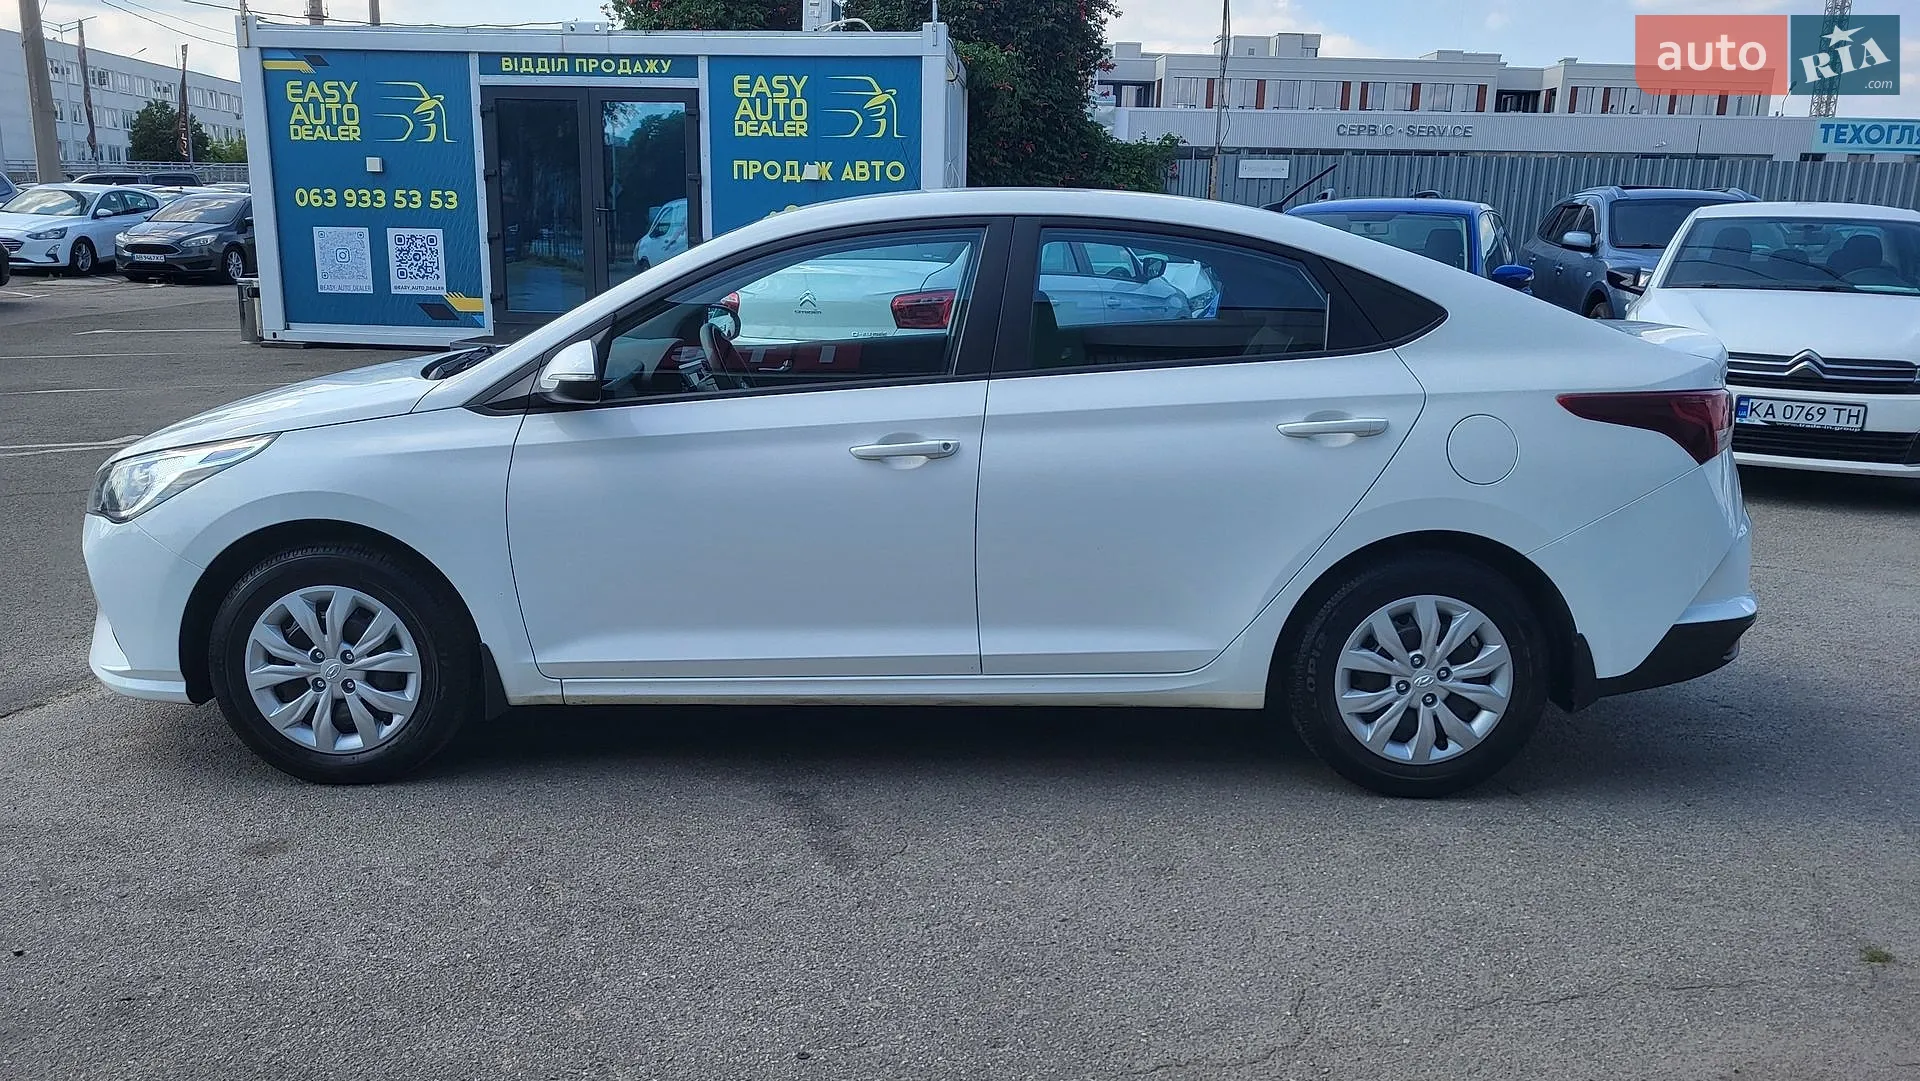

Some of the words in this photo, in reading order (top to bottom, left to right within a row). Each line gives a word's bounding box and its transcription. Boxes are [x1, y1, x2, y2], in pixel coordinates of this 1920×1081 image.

[501, 57, 569, 74] ВІДДІЛ
[575, 58, 672, 75] ПРОДАЖУ
[286, 80, 359, 103] EASY
[733, 75, 809, 98] EASY
[289, 103, 360, 125] AUTO
[734, 98, 808, 121] AUTO
[289, 125, 361, 141] DEALER
[734, 120, 808, 137] DEALER
[1406, 124, 1473, 138] SERVICE
[841, 161, 906, 182] АВТО
[295, 187, 337, 208] 063
[343, 188, 386, 208] 933
[394, 189, 422, 209] 53
[429, 190, 458, 210] 53
[1750, 402, 1776, 419] KA
[1782, 405, 1827, 422] 0769
[1833, 408, 1861, 425] TH
